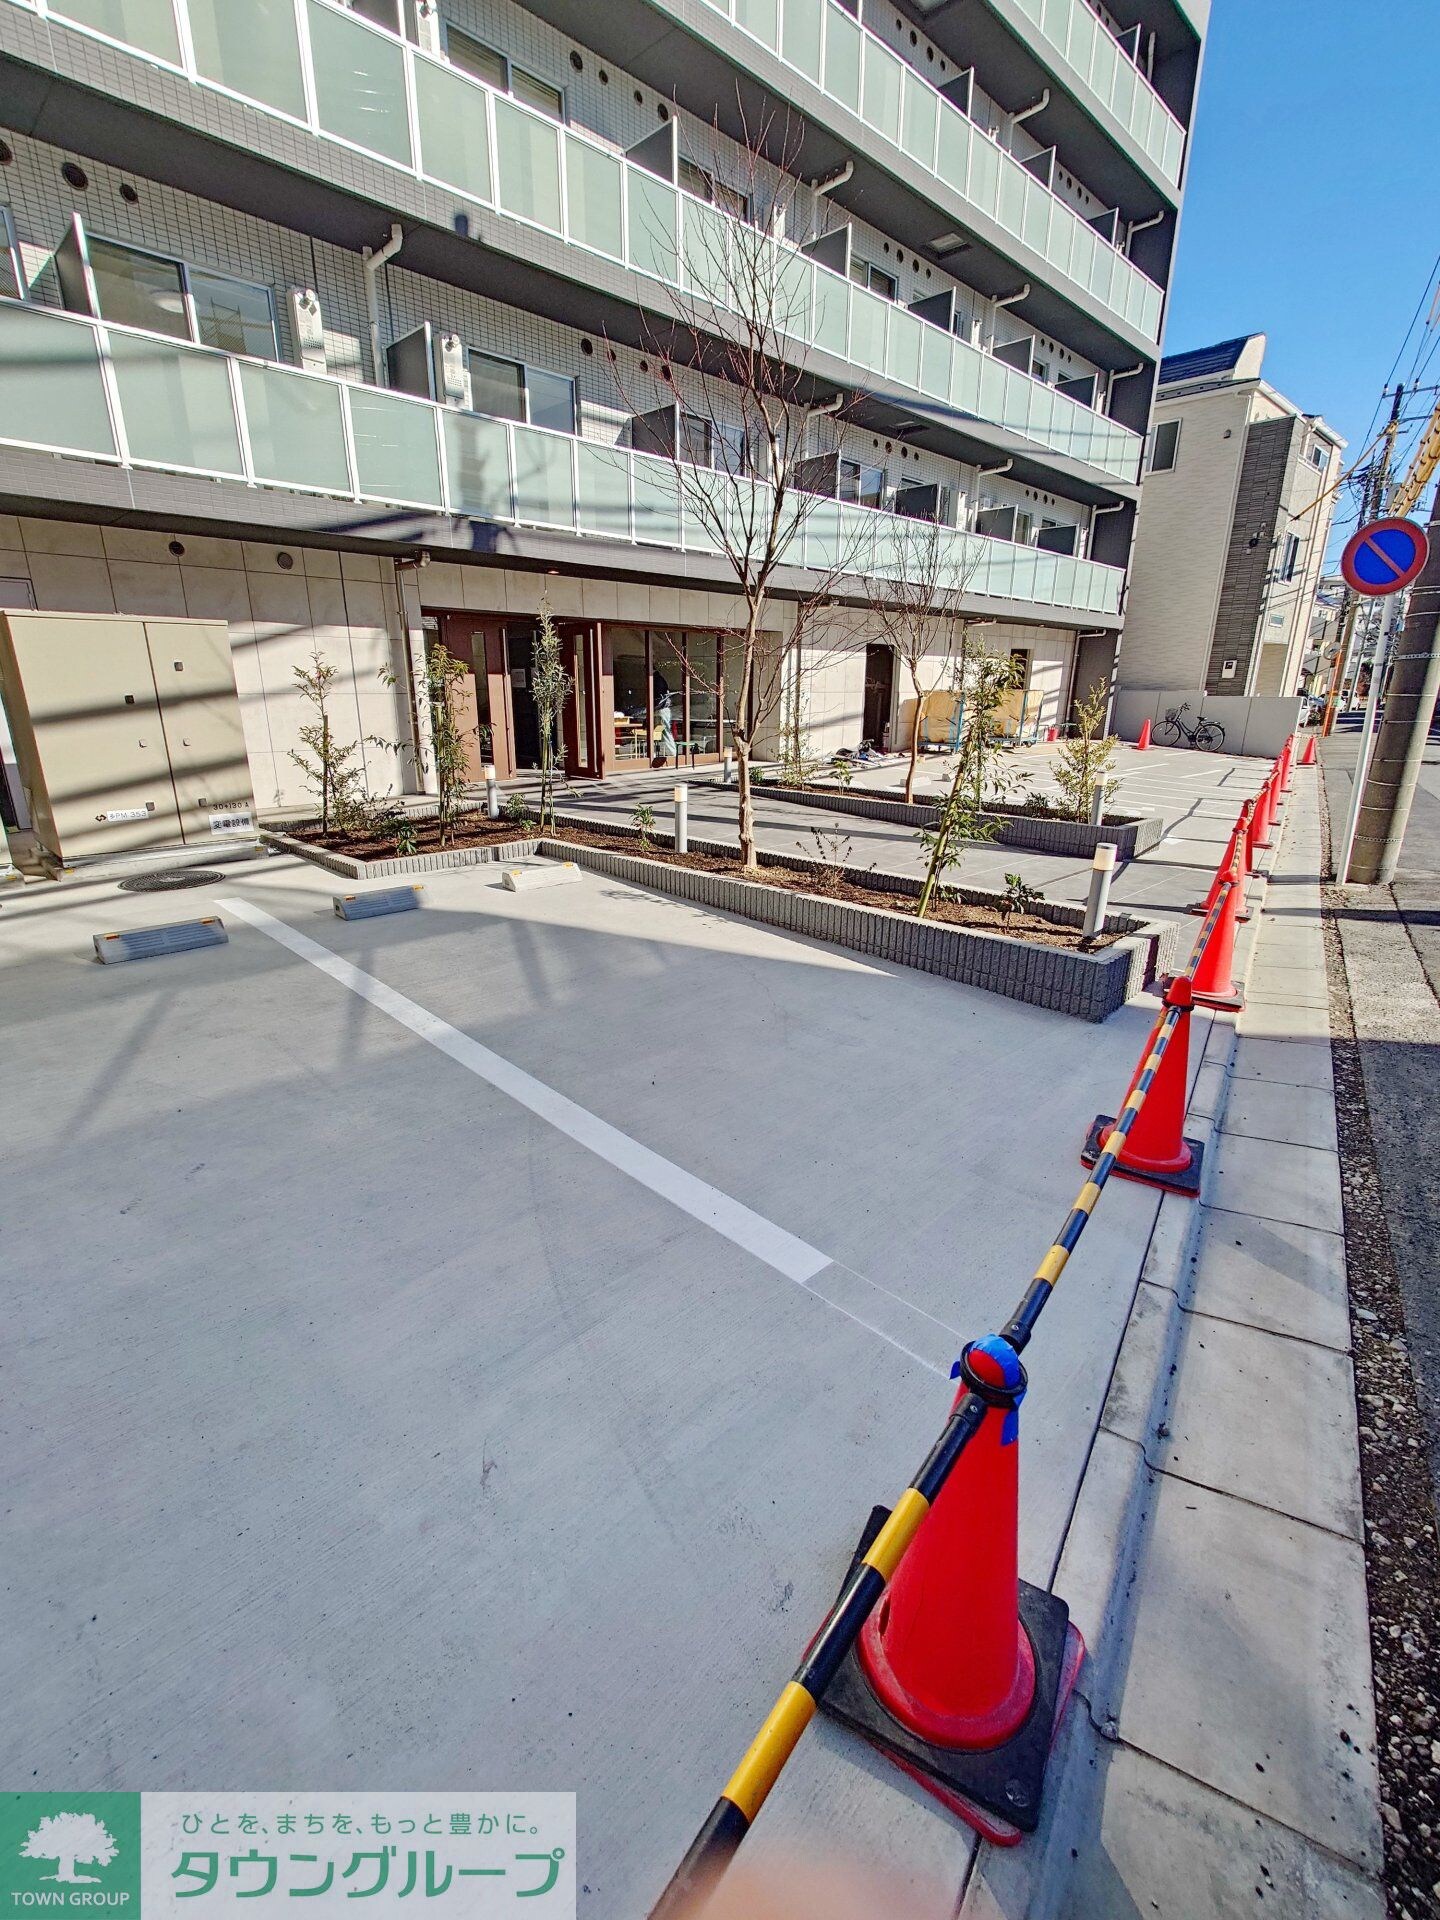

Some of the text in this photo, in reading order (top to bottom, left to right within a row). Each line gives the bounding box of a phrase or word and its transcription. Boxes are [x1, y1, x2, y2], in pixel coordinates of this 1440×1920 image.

[130, 810, 146, 818] 353
[213, 817, 250, 830] 変電設備
